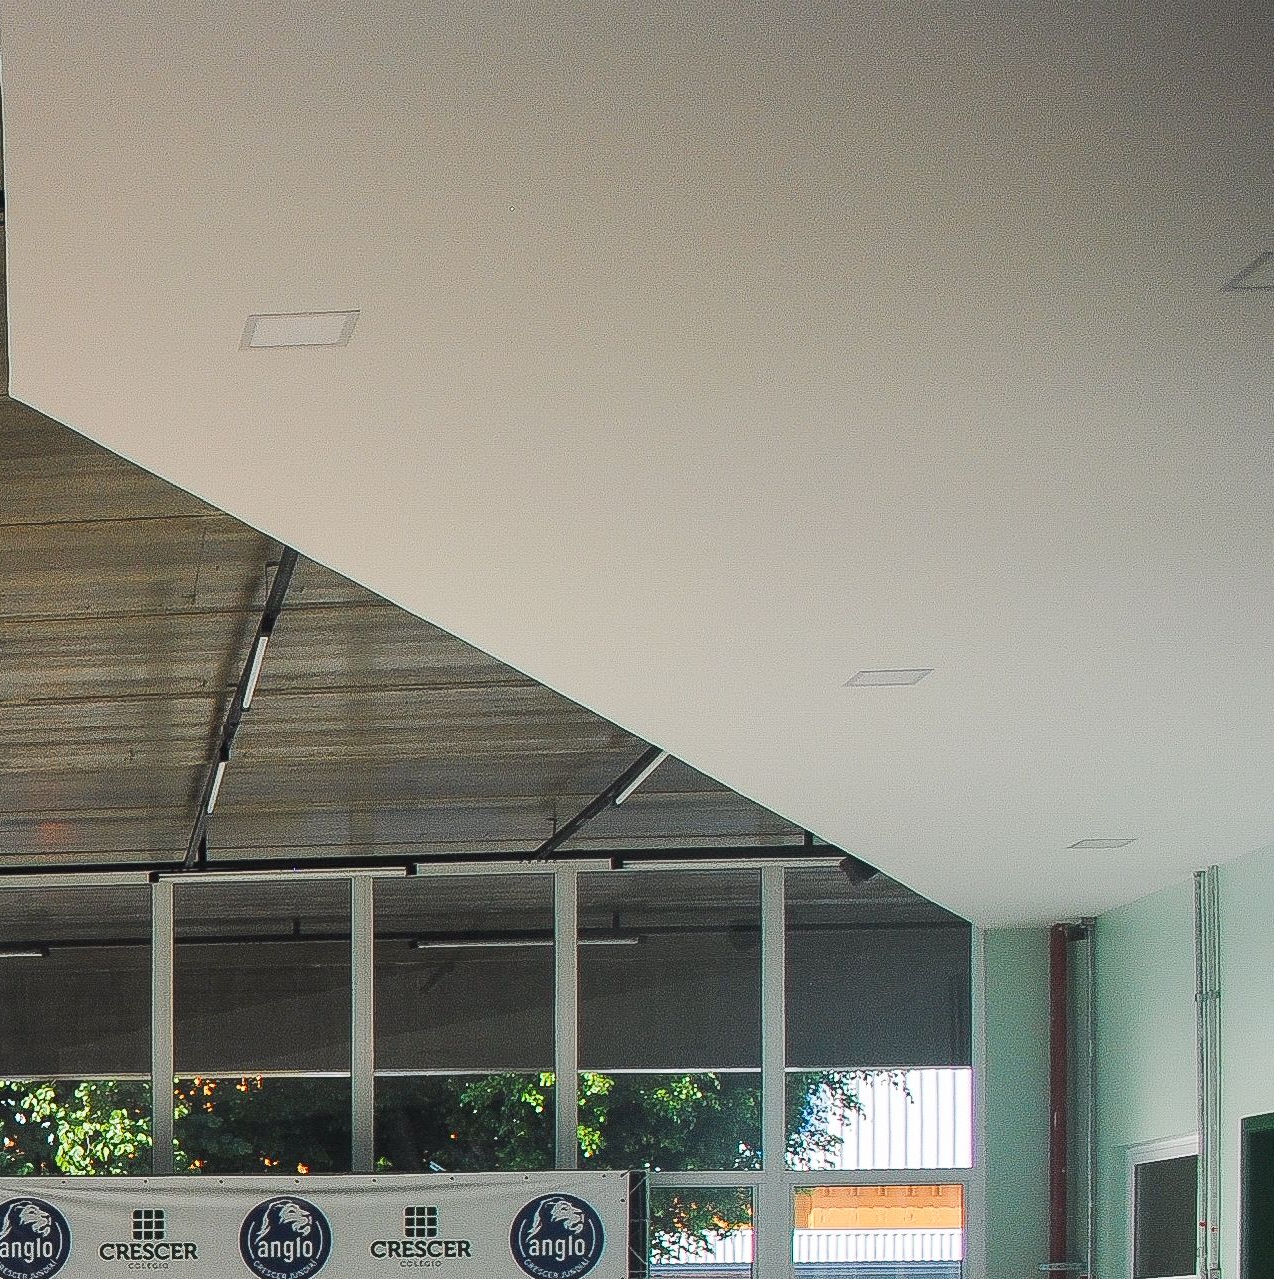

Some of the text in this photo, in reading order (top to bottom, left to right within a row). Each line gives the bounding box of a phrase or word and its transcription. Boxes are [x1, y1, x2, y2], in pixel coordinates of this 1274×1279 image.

[0, 1238, 53, 1263] anglo
[99, 1243, 198, 1261] CRESCER
[258, 1237, 313, 1262] anglo
[370, 1240, 472, 1258] CRESCER
[529, 1235, 586, 1262] anglo
